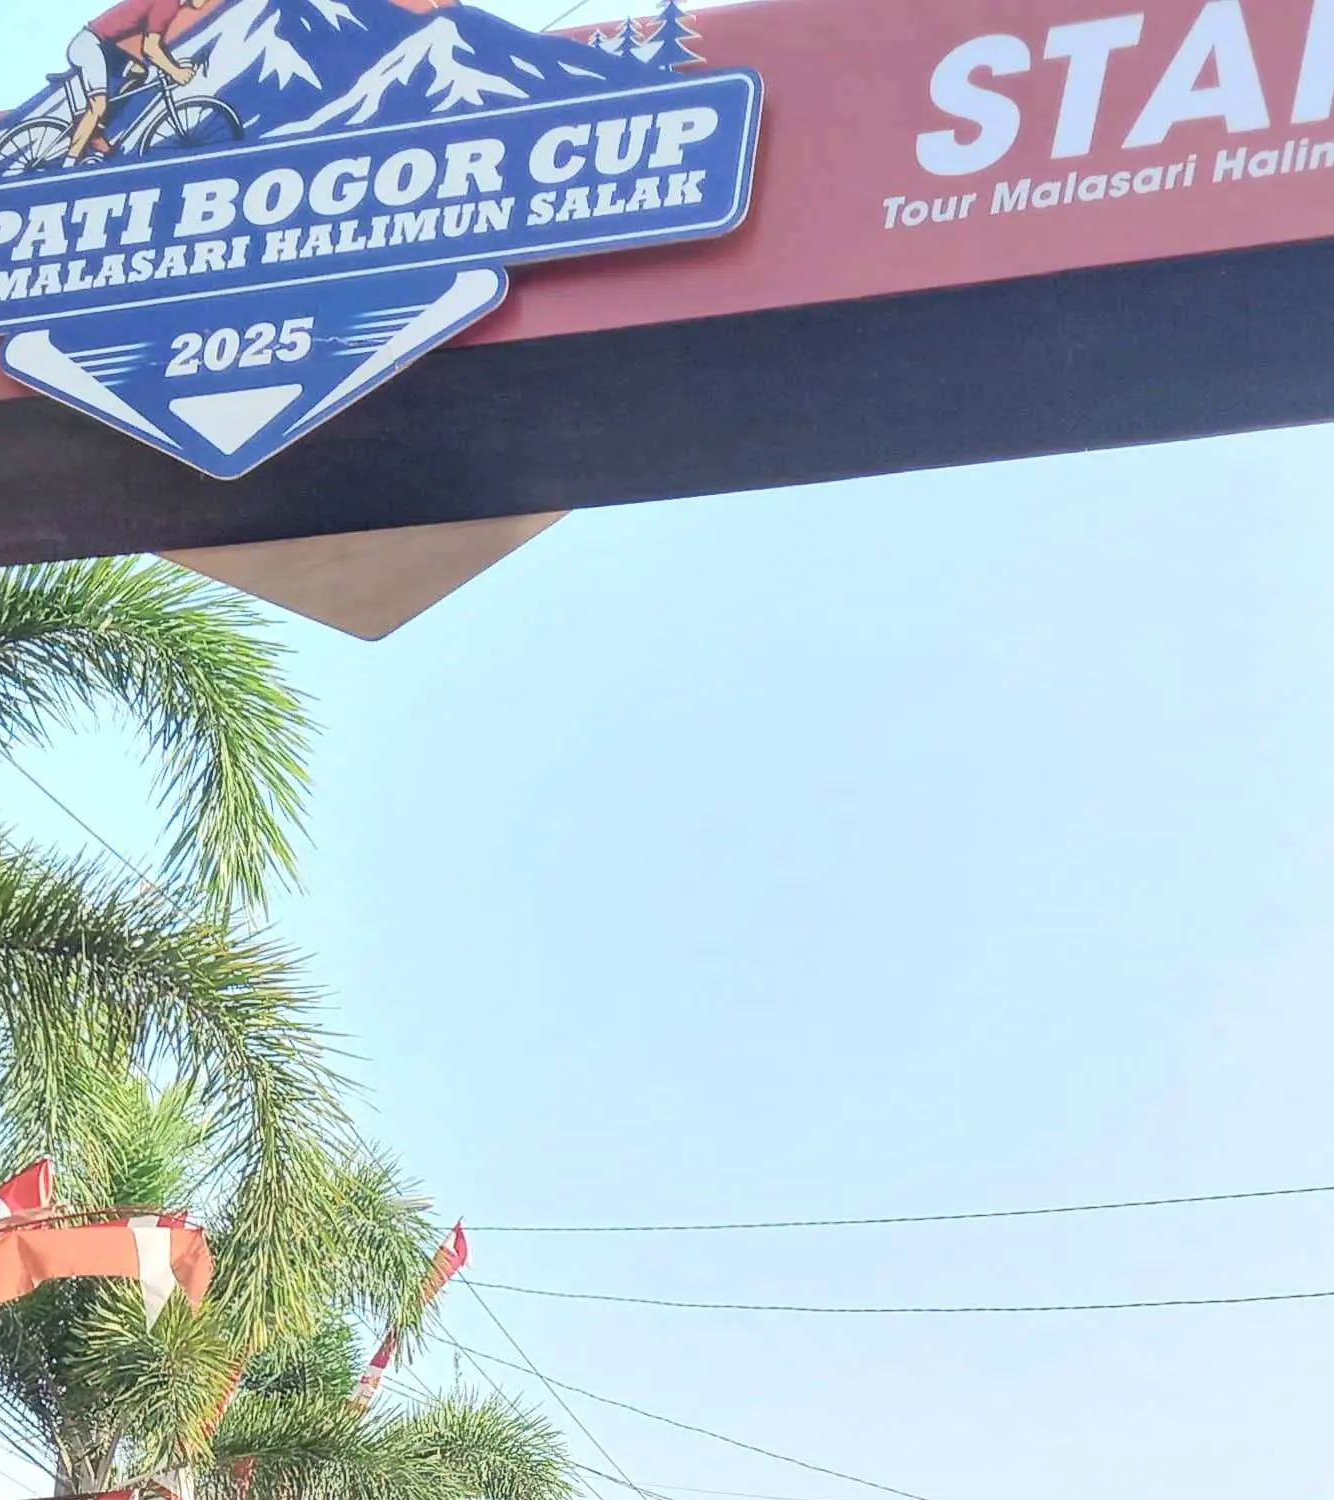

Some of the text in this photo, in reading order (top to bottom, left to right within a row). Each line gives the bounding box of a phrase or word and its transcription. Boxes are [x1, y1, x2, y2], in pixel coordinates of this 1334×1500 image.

[175, 136, 503, 239] BOGOR
[535, 105, 721, 184] CUP
[882, 190, 977, 230] Tour
[990, 154, 1197, 216] Malasari
[263, 199, 514, 265] HALIMUN
[527, 169, 707, 227] SALAK
[165, 316, 317, 380] 2025
